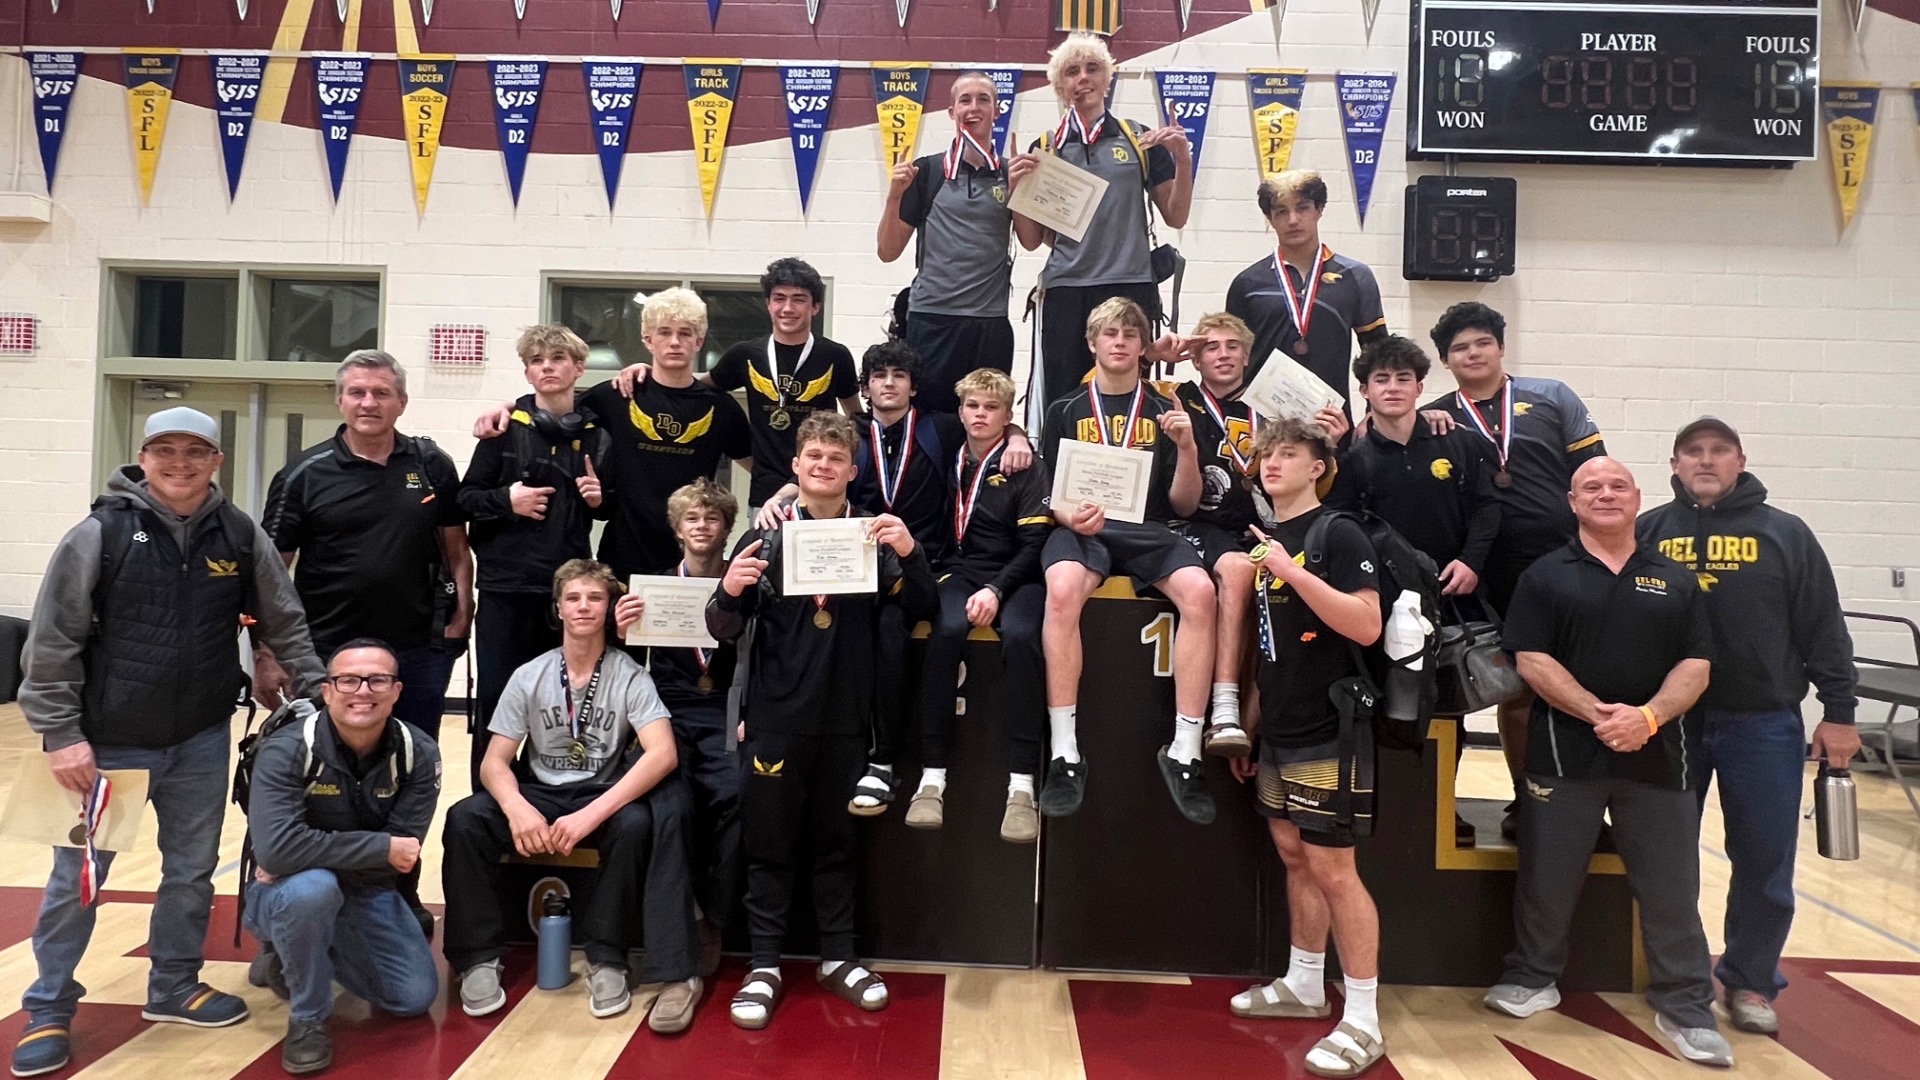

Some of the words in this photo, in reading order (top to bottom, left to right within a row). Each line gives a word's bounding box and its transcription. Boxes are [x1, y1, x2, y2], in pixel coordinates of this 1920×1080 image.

[1431, 30, 1495, 48] FOULS
[1581, 33, 1657, 52] PLAYER
[1746, 36, 1811, 54] FOULS
[218, 58, 259, 66] 2022-2023
[320, 61, 362, 70] 2022-2023
[497, 64, 539, 73] 2022-2023
[592, 66, 634, 75] 2022-2023
[700, 68, 723, 77] GIRLS
[788, 69, 830, 78] 2022-2023
[890, 71, 911, 80] BOYS
[410, 74, 444, 83] SOCCER
[694, 78, 729, 89] TRACK
[1165, 74, 1208, 84] 2022-2023
[1265, 77, 1288, 86] GIRLS
[1343, 79, 1388, 88] 2023-2024
[42, 80, 74, 96] SJS
[226, 85, 259, 100] SJS
[883, 81, 918, 92] TRACK
[330, 88, 361, 103] SJS
[506, 91, 538, 106] SJS
[600, 93, 633, 109] SJS
[1342, 93, 1389, 101] CHAMPIONS
[693, 100, 728, 108] 2022-23
[796, 95, 830, 111] SJS
[882, 103, 918, 111] 2022-23
[45, 118, 60, 132] D1
[140, 98, 154, 151] SFL
[1437, 111, 1485, 129] WON
[1589, 115, 1648, 132] GAME
[1753, 118, 1802, 136] WON
[227, 122, 244, 136] D2
[331, 126, 347, 140] D2
[417, 104, 432, 157] SFL
[508, 129, 525, 143] D2
[603, 132, 619, 146] D2
[702, 110, 717, 163] SFL
[800, 134, 814, 149] D1
[1268, 118, 1283, 172] SFL
[1354, 150, 1375, 164] D2
[1840, 133, 1858, 187] SFL
[656, 412, 682, 437] DO
[1706, 535, 1759, 563] ORO
[1141, 612, 1175, 677] 1
